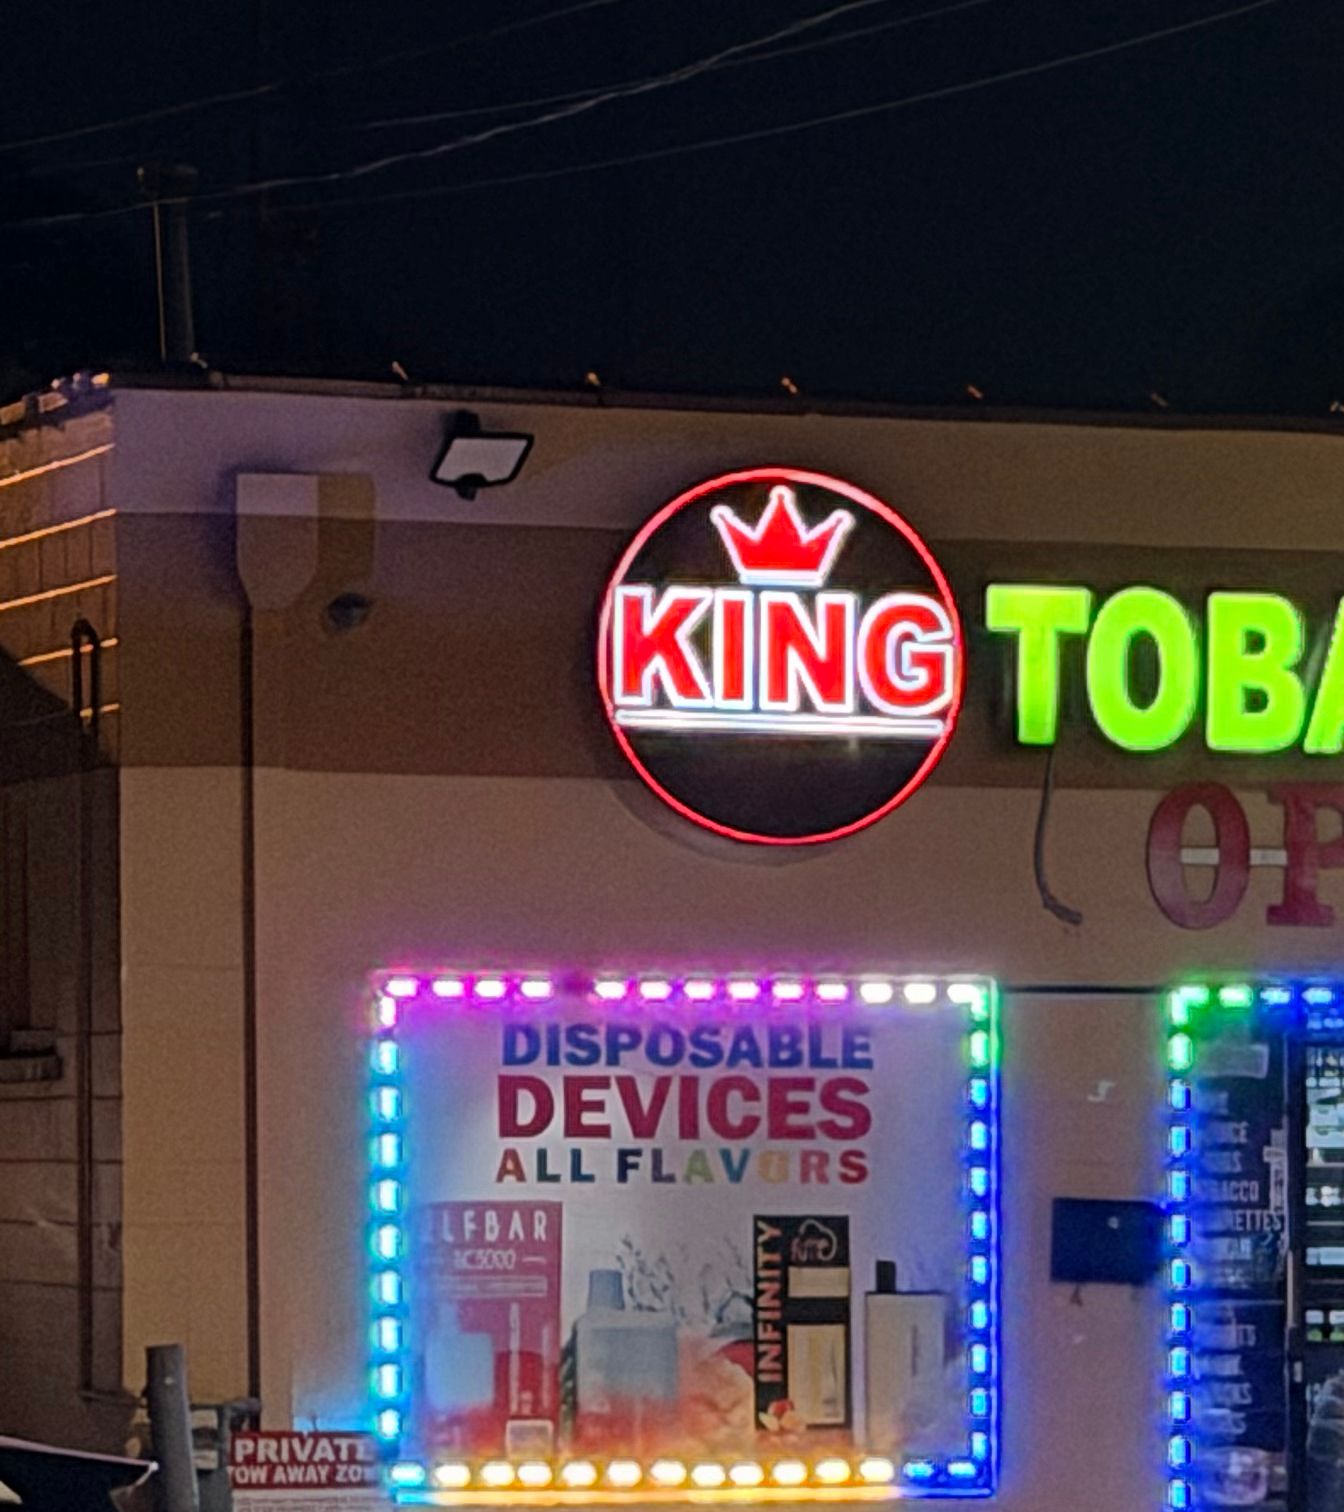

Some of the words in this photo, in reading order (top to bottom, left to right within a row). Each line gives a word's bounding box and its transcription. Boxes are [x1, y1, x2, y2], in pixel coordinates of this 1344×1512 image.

[614, 586, 954, 715] KING
[502, 1023, 874, 1070] DISPOSABLE
[497, 1074, 873, 1141] DEVICES
[496, 1148, 596, 1184] ALL
[616, 1148, 870, 1186] FLAVORS
[757, 1220, 783, 1383] INFINITY
[273, 1464, 329, 1485] AWAY
[335, 1463, 379, 1484] ZO
